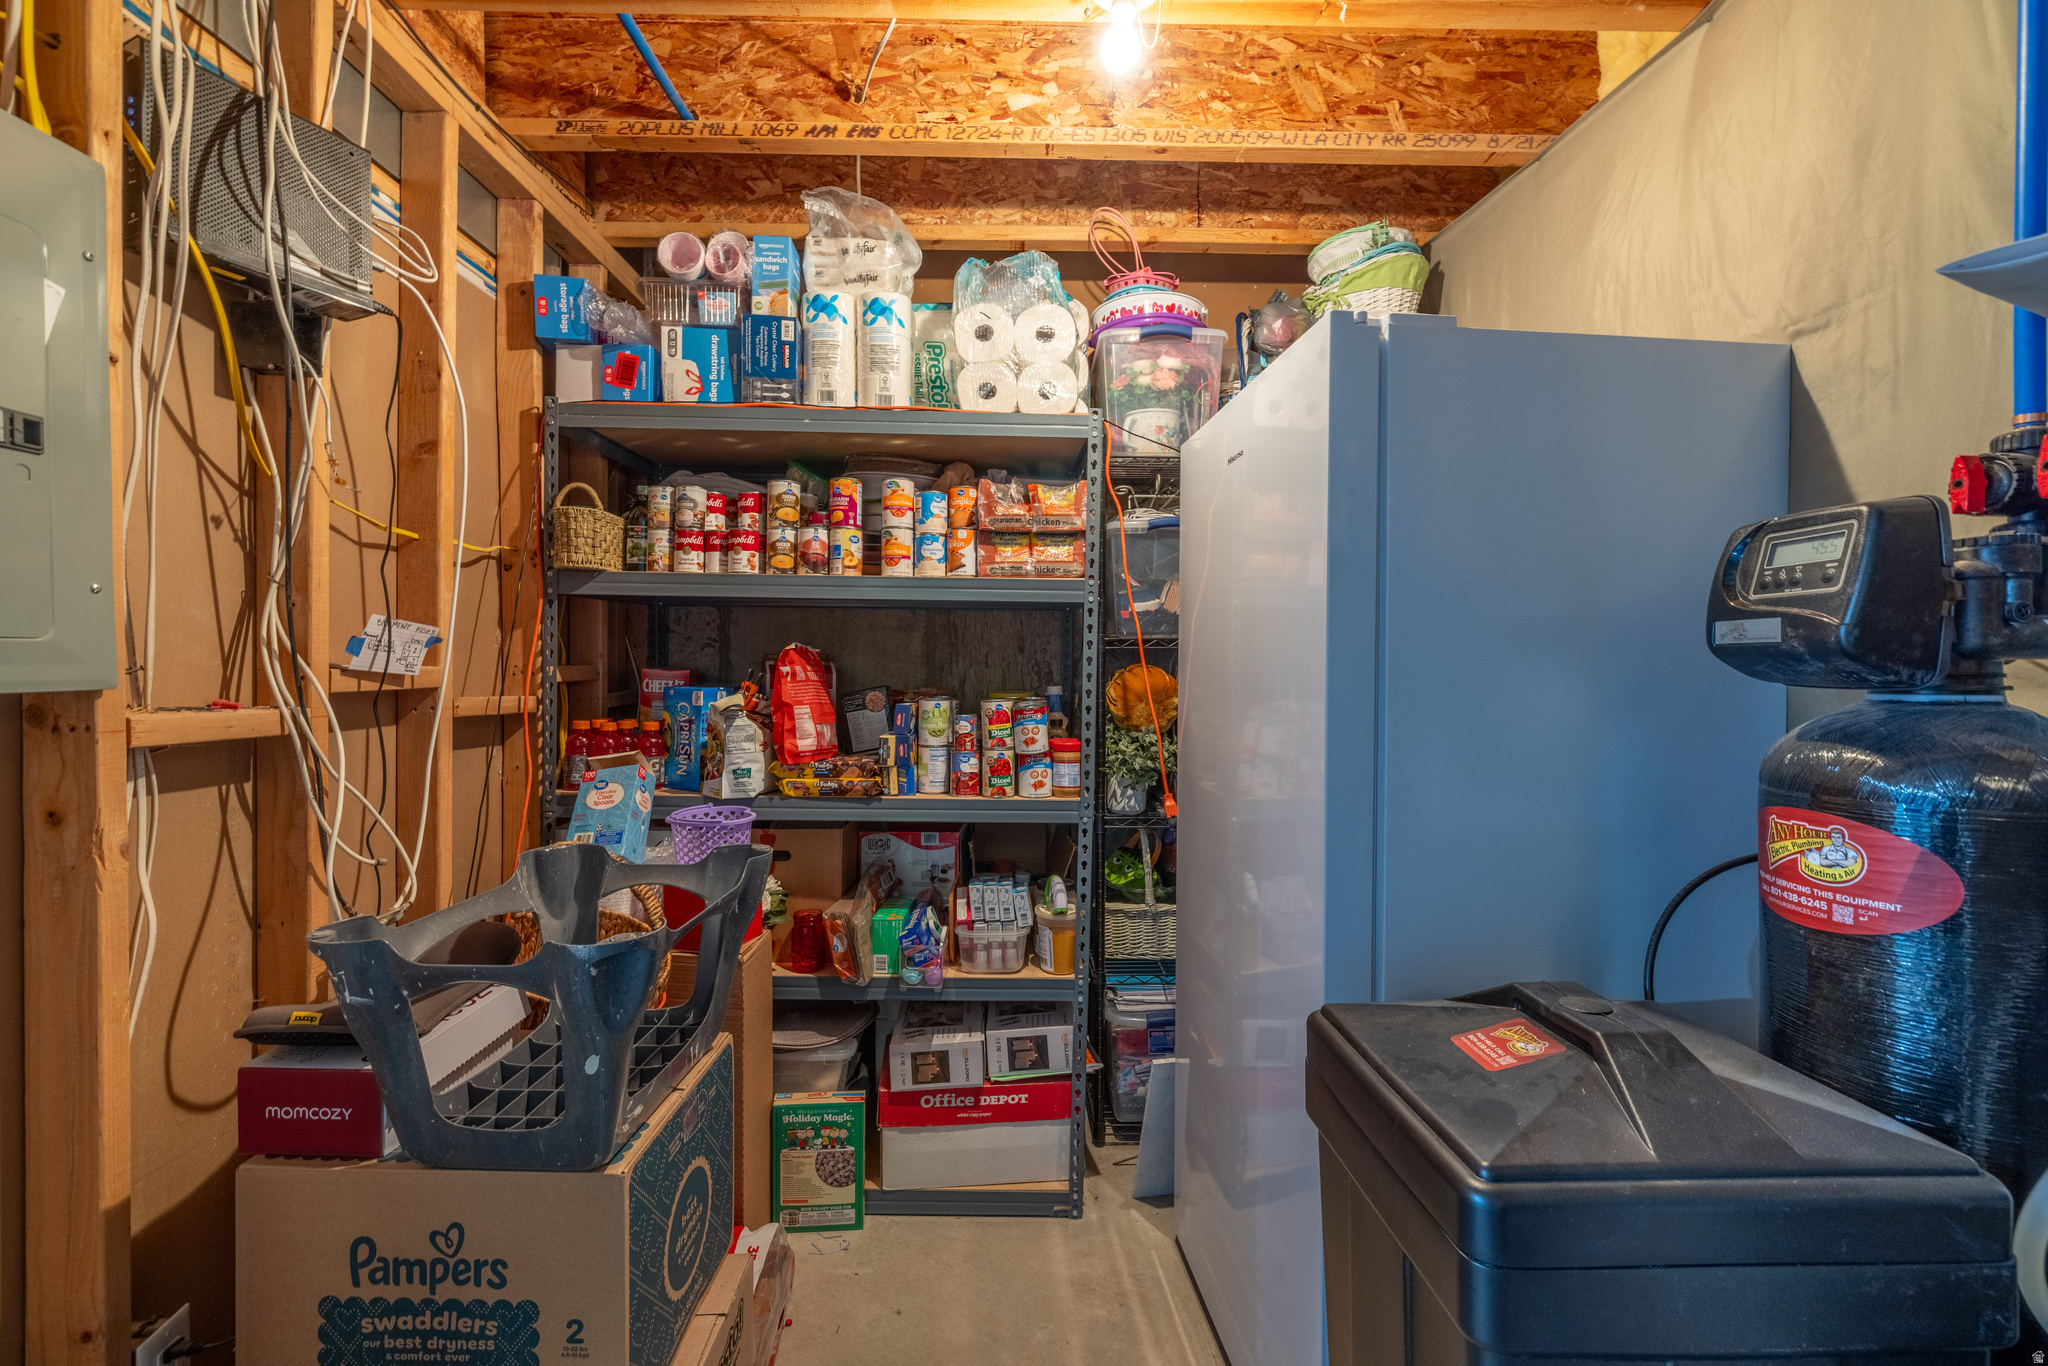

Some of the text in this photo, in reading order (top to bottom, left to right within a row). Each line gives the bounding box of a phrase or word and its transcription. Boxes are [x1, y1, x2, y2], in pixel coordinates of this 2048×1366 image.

[617, 121, 696, 136] 20PLUS
[700, 122, 743, 136] MILL
[750, 122, 799, 137] 1069
[804, 124, 838, 138] APA
[846, 124, 884, 138] EWS
[889, 125, 941, 139] CCMC
[946, 126, 1023, 141] 12724-R
[1031, 128, 1096, 142] ICC-ES
[1102, 128, 1147, 143] 1305
[1334, 133, 1380, 147] CITY
[1382, 133, 1406, 147] RR
[1412, 134, 1477, 148] 25099
[762, 263, 780, 271] bags
[559, 283, 569, 333] storage bags
[708, 334, 719, 402] drawstring bags
[991, 728, 1011, 737] Diced
[990, 776, 1011, 784] Diced
[593, 799, 615, 807] Spoons
[1769, 819, 1827, 842] ANY HOUR
[1792, 839, 1825, 851] Plumbing
[1804, 862, 1837, 881] Heating
[1844, 869, 1856, 877] Air
[1762, 882, 1828, 911] CALL 801-438-6245
[1766, 872, 1776, 882] HELP
[1776, 877, 1812, 895] SERVICING
[1813, 888, 1834, 900] THIS
[1836, 893, 1903, 913] EQUIPMENT
[1857, 909, 1879, 918] SCAN
[920, 1093, 1028, 1108] Office DEPOT
[265, 1106, 353, 1121] momcozy
[782, 1112, 855, 1124] Holiday Magic.
[682, 1196, 698, 1228] best
[675, 1203, 703, 1254] dryness
[350, 1235, 509, 1296] Pampers
[361, 1310, 498, 1336] swaddlers
[566, 1319, 585, 1344] 2
[363, 1335, 495, 1352] our best dryness
[386, 1351, 470, 1362] & comfort ever
